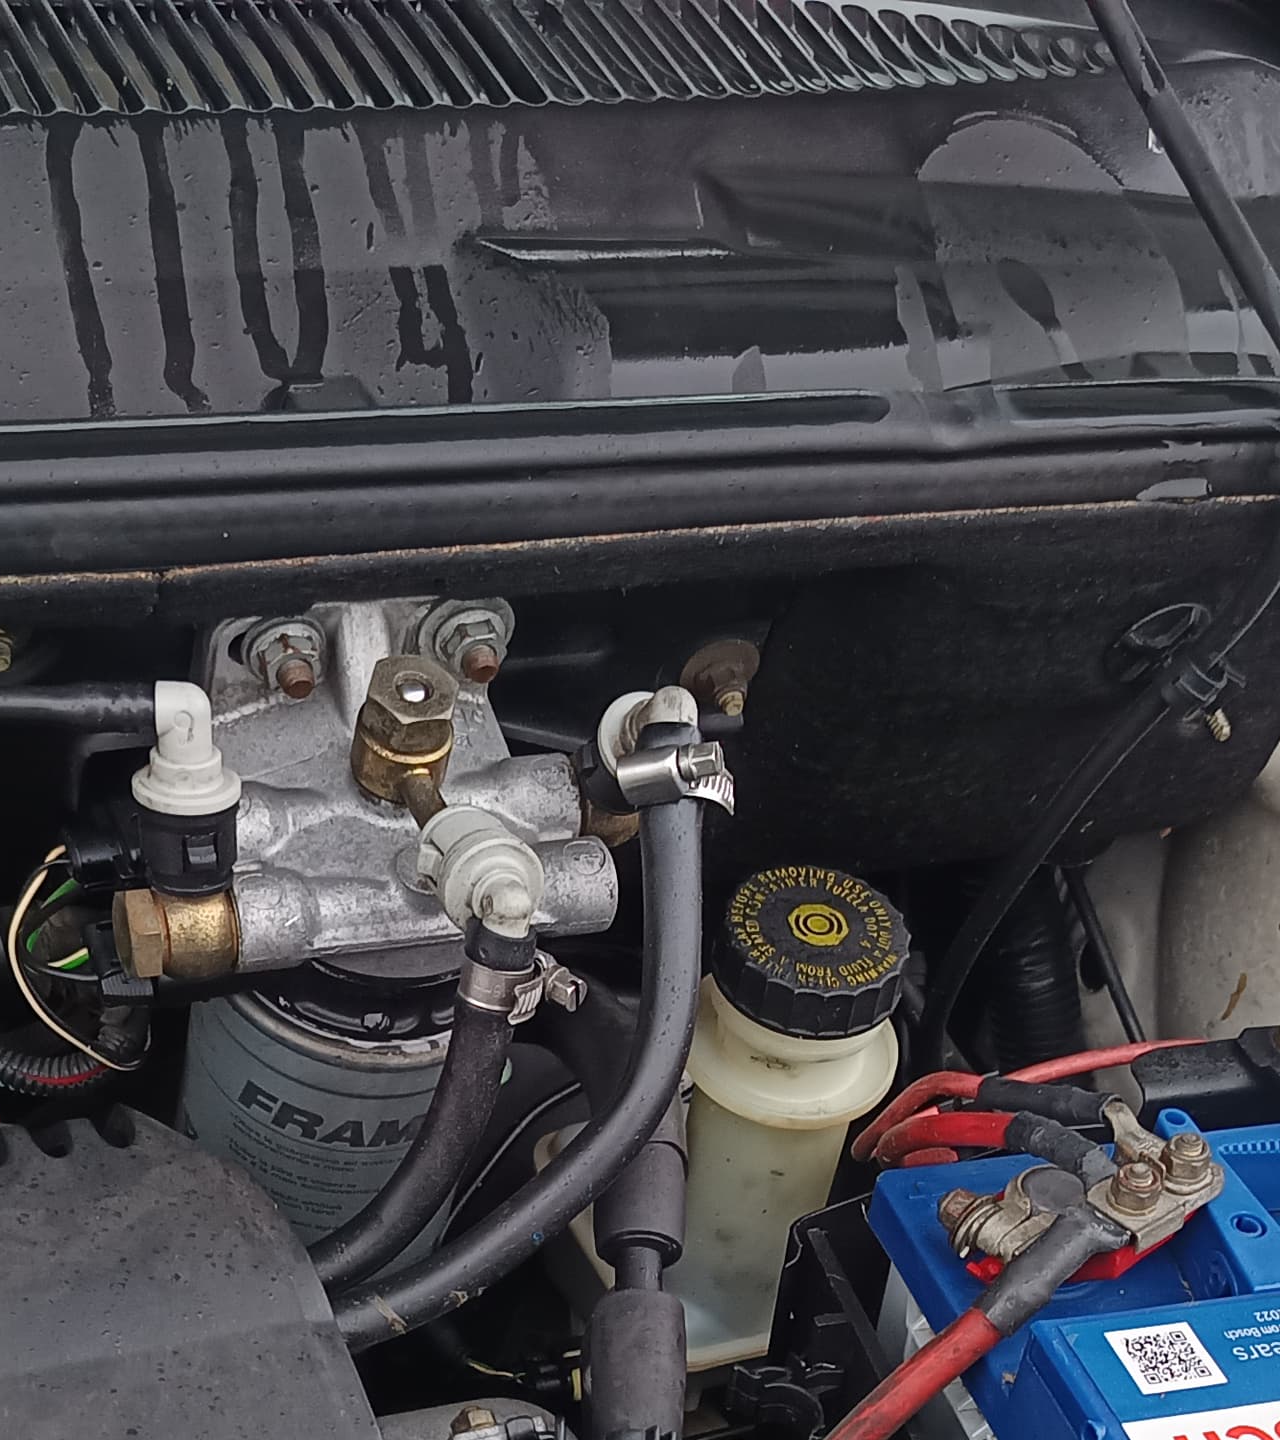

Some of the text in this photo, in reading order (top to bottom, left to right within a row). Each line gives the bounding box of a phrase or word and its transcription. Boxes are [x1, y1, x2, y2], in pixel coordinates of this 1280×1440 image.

[757, 866, 836, 883] REMOVING
[842, 878, 871, 899] USE
[795, 962, 832, 978] FROM
[839, 954, 875, 977] FLUID
[235, 1078, 429, 1148] FRAM
[1223, 1326, 1258, 1341] Bosch
